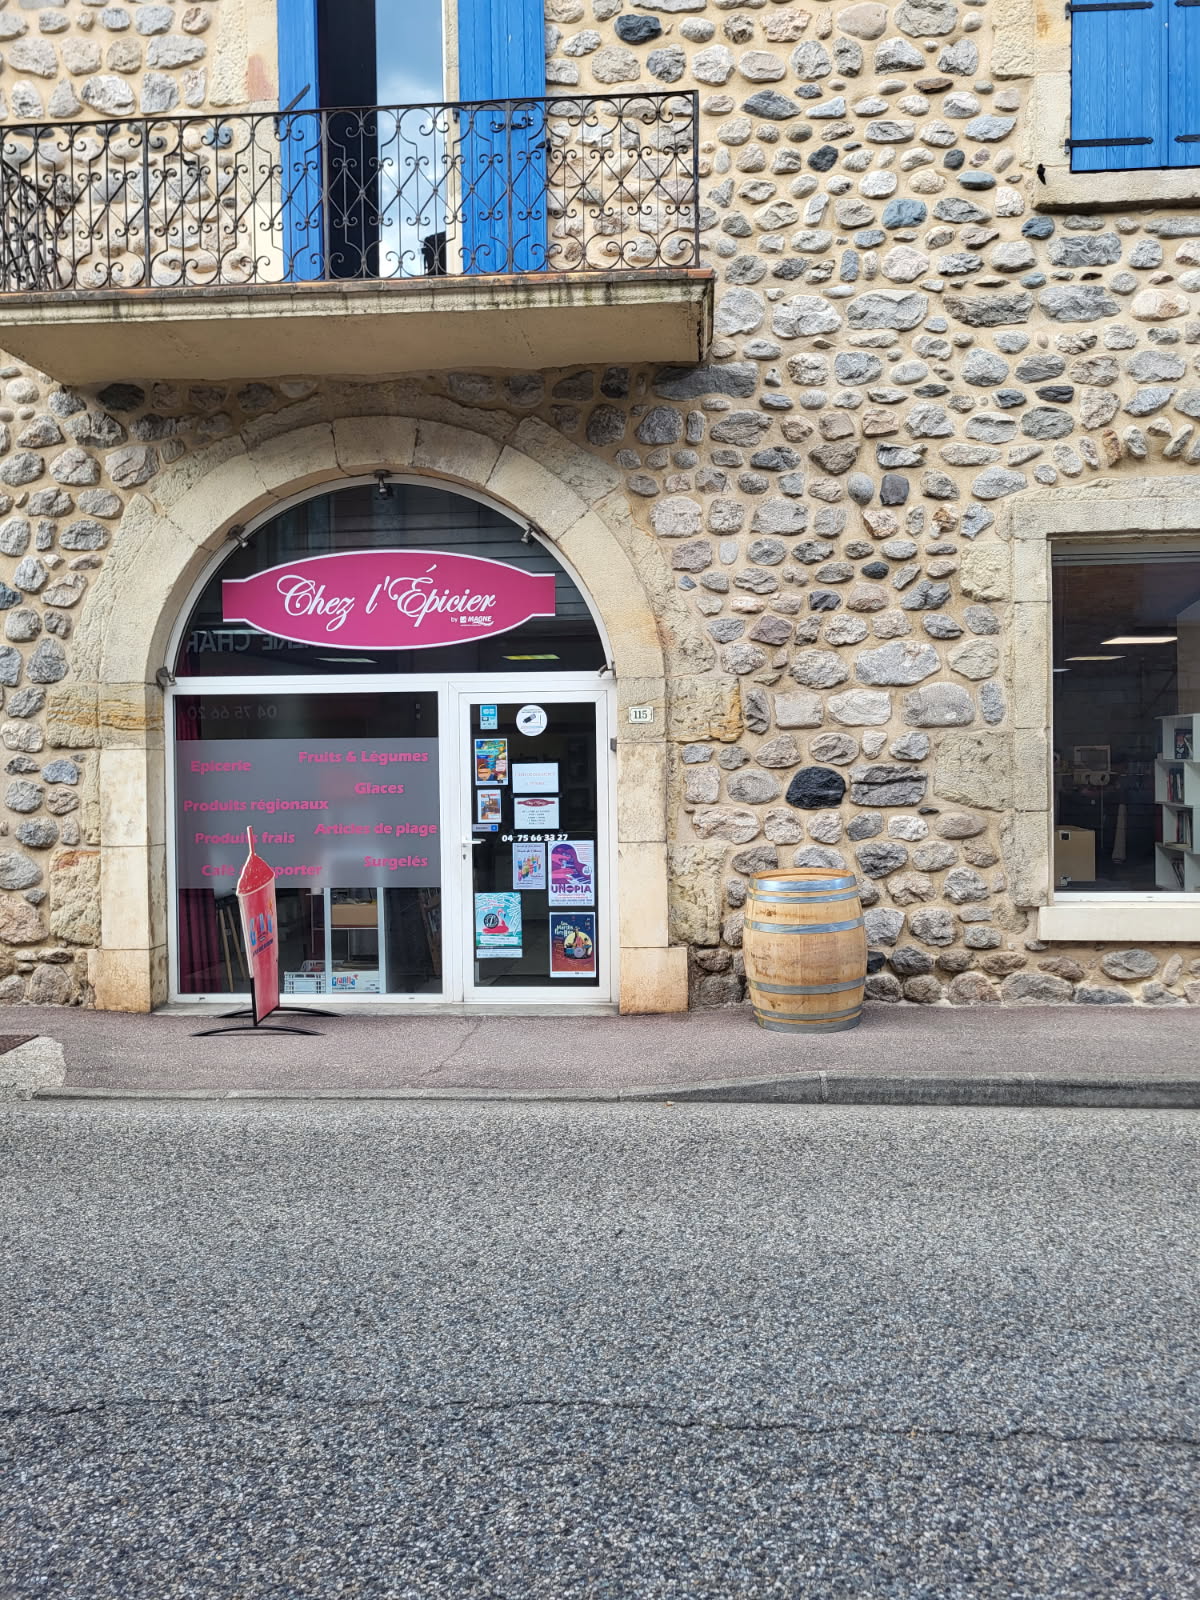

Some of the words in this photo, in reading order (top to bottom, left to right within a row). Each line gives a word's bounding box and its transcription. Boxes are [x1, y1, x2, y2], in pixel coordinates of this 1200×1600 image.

[276, 574, 355, 632] Chez
[365, 564, 496, 628] l'Épicier
[467, 615, 493, 623] MAGNE
[633, 710, 648, 719] 115
[298, 751, 342, 763] Fruits
[346, 751, 357, 762] &
[361, 751, 428, 766] Légumes
[191, 760, 251, 775] Epicerie
[354, 782, 404, 794] Glaces
[183, 800, 247, 811] Produits
[250, 798, 329, 814] régionaux
[313, 823, 371, 835] Articles
[374, 823, 393, 834] de
[396, 823, 437, 837] plage
[195, 832, 258, 844] Produis
[262, 832, 295, 844] frais
[543, 833, 555, 841] 33
[557, 833, 569, 841] 27
[363, 855, 428, 871] Surgelés
[201, 864, 236, 877] Café
[551, 884, 592, 893] UNOPIA
